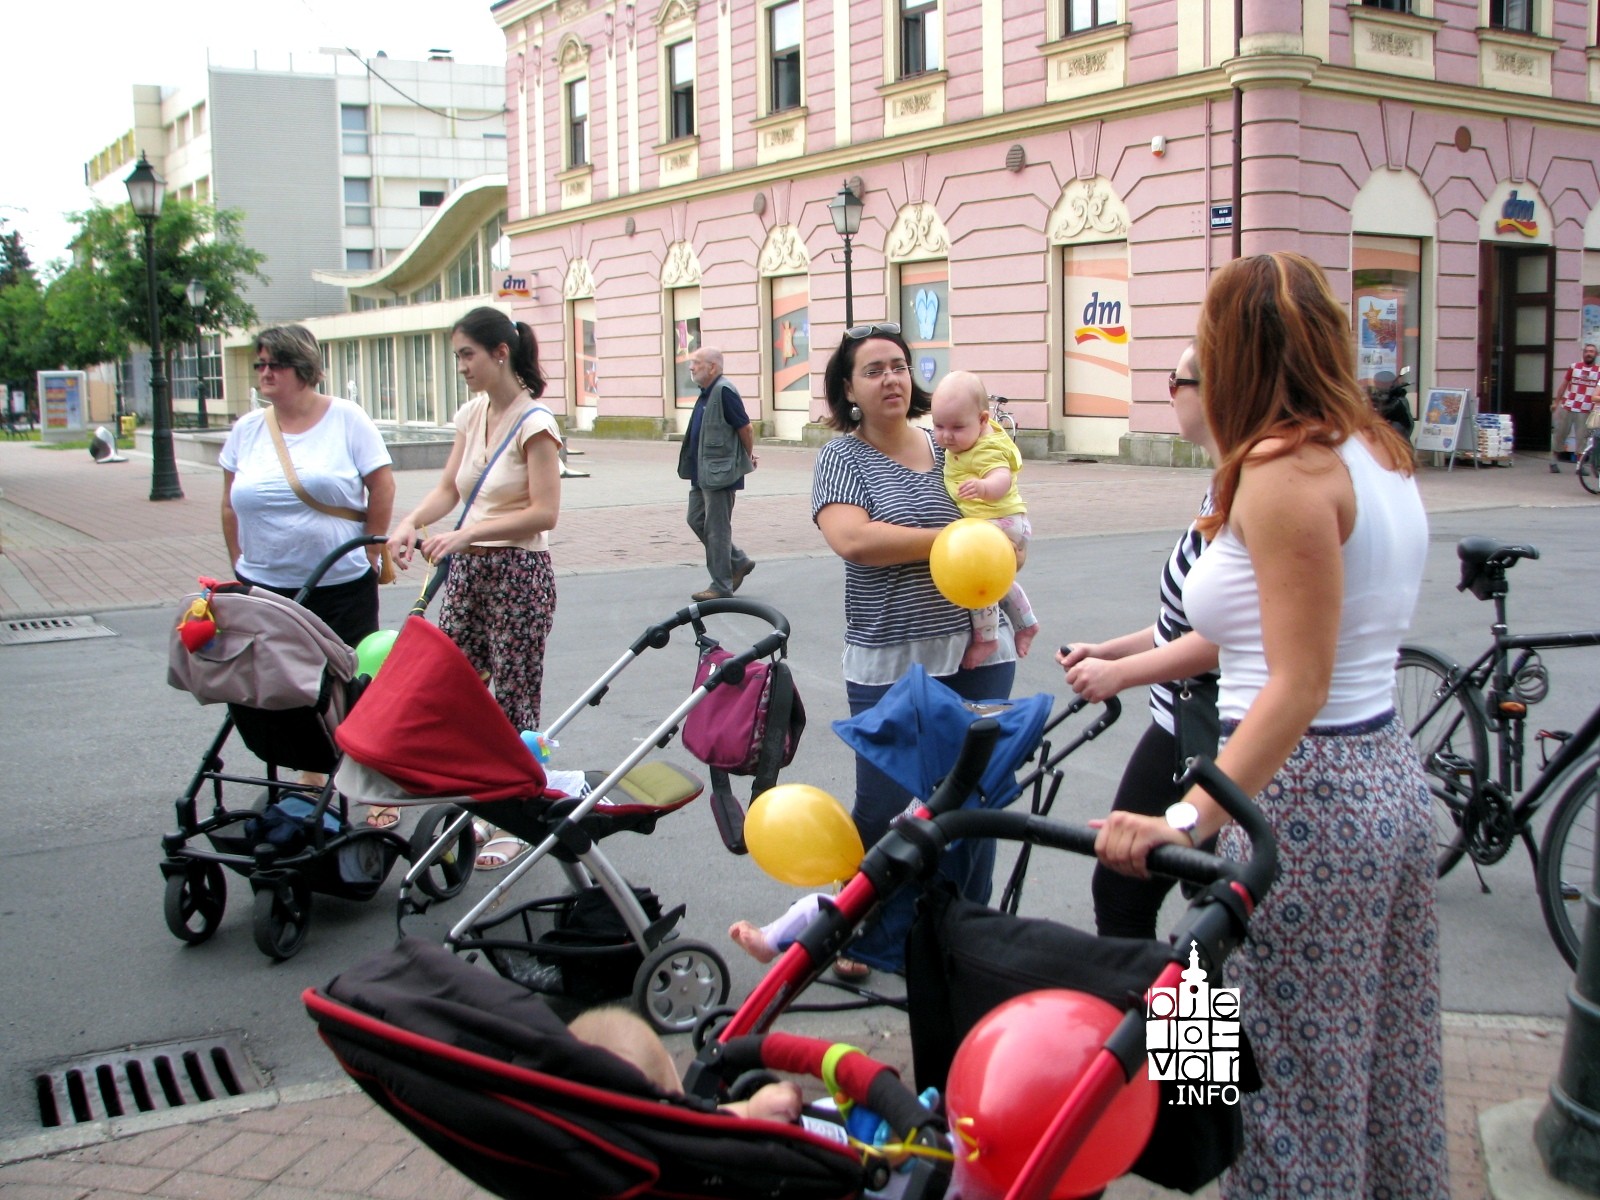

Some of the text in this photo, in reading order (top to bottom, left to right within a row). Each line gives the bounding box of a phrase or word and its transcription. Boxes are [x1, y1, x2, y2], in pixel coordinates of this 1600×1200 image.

[1502, 190, 1534, 221] dm
[503, 275, 525, 290] dm
[1083, 292, 1121, 325] dm
